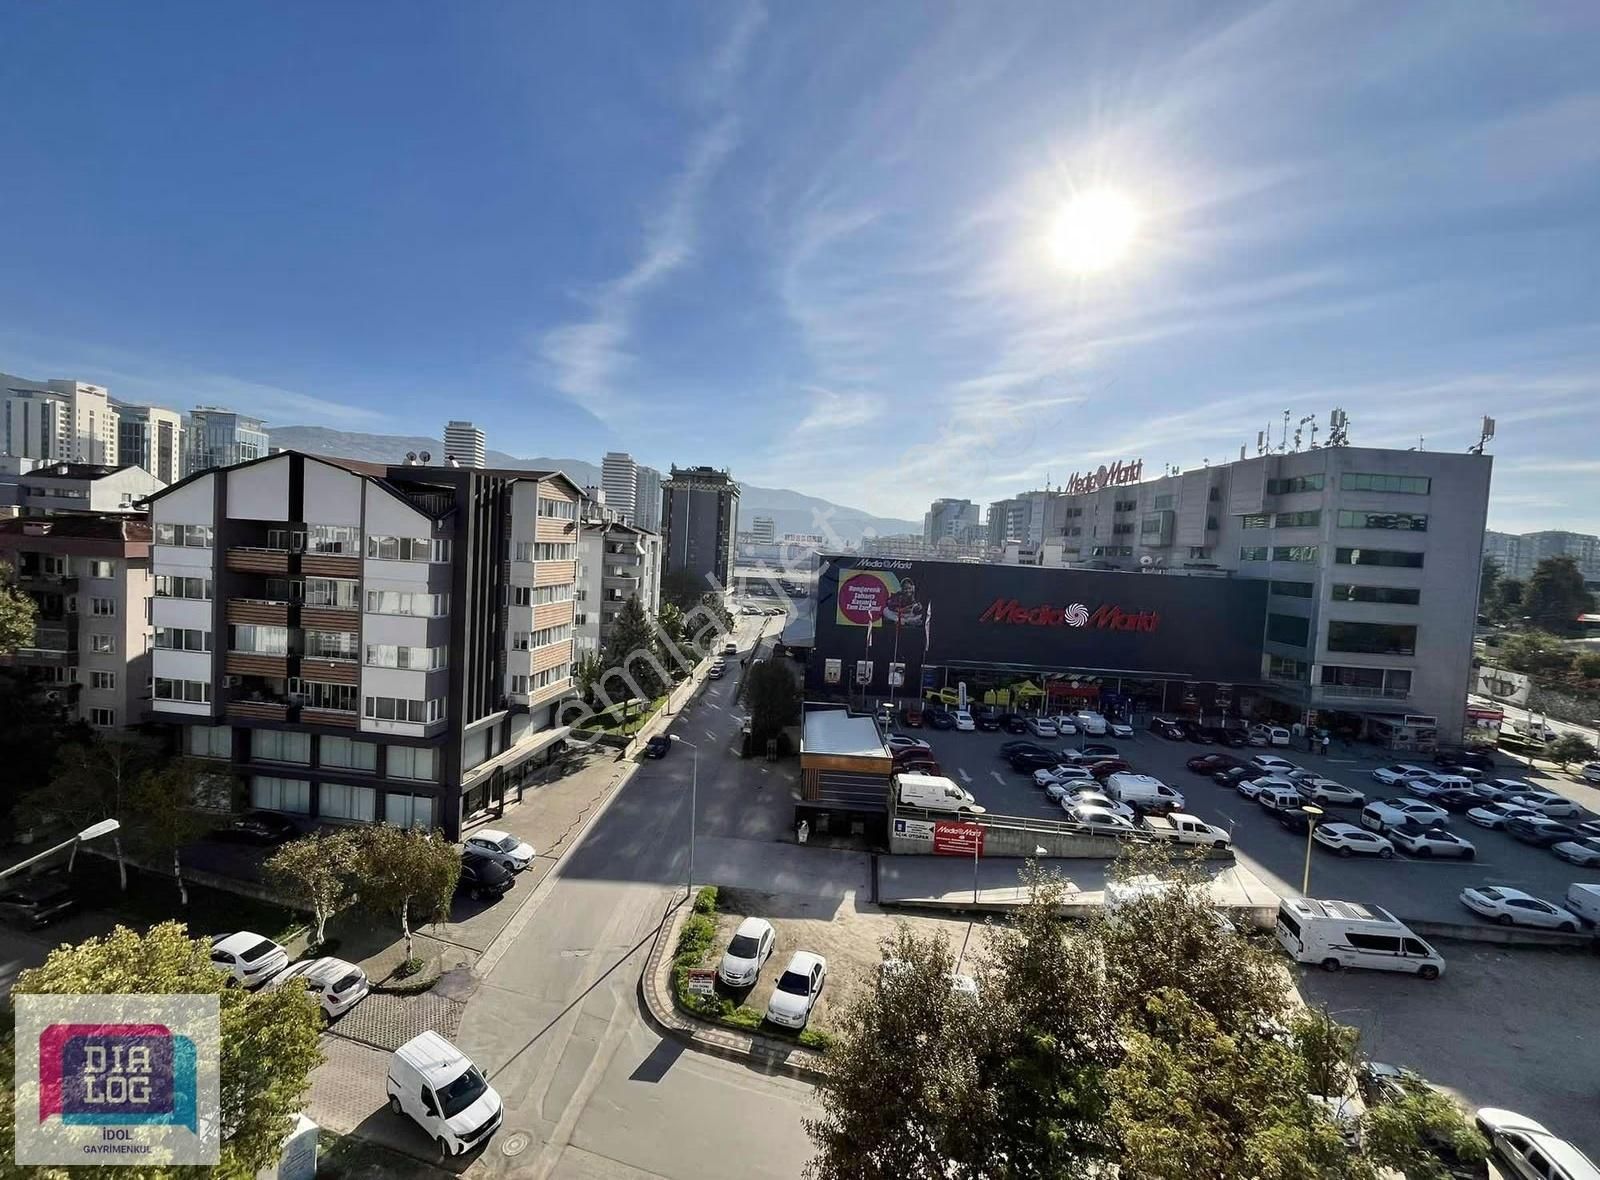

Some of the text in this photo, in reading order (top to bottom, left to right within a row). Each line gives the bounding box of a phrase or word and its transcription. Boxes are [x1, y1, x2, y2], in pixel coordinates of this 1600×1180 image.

[1065, 458, 1143, 495] Media Markt
[856, 558, 913, 570] Media Markt
[979, 597, 1162, 633] Media Markt
[936, 825, 958, 835] Media
